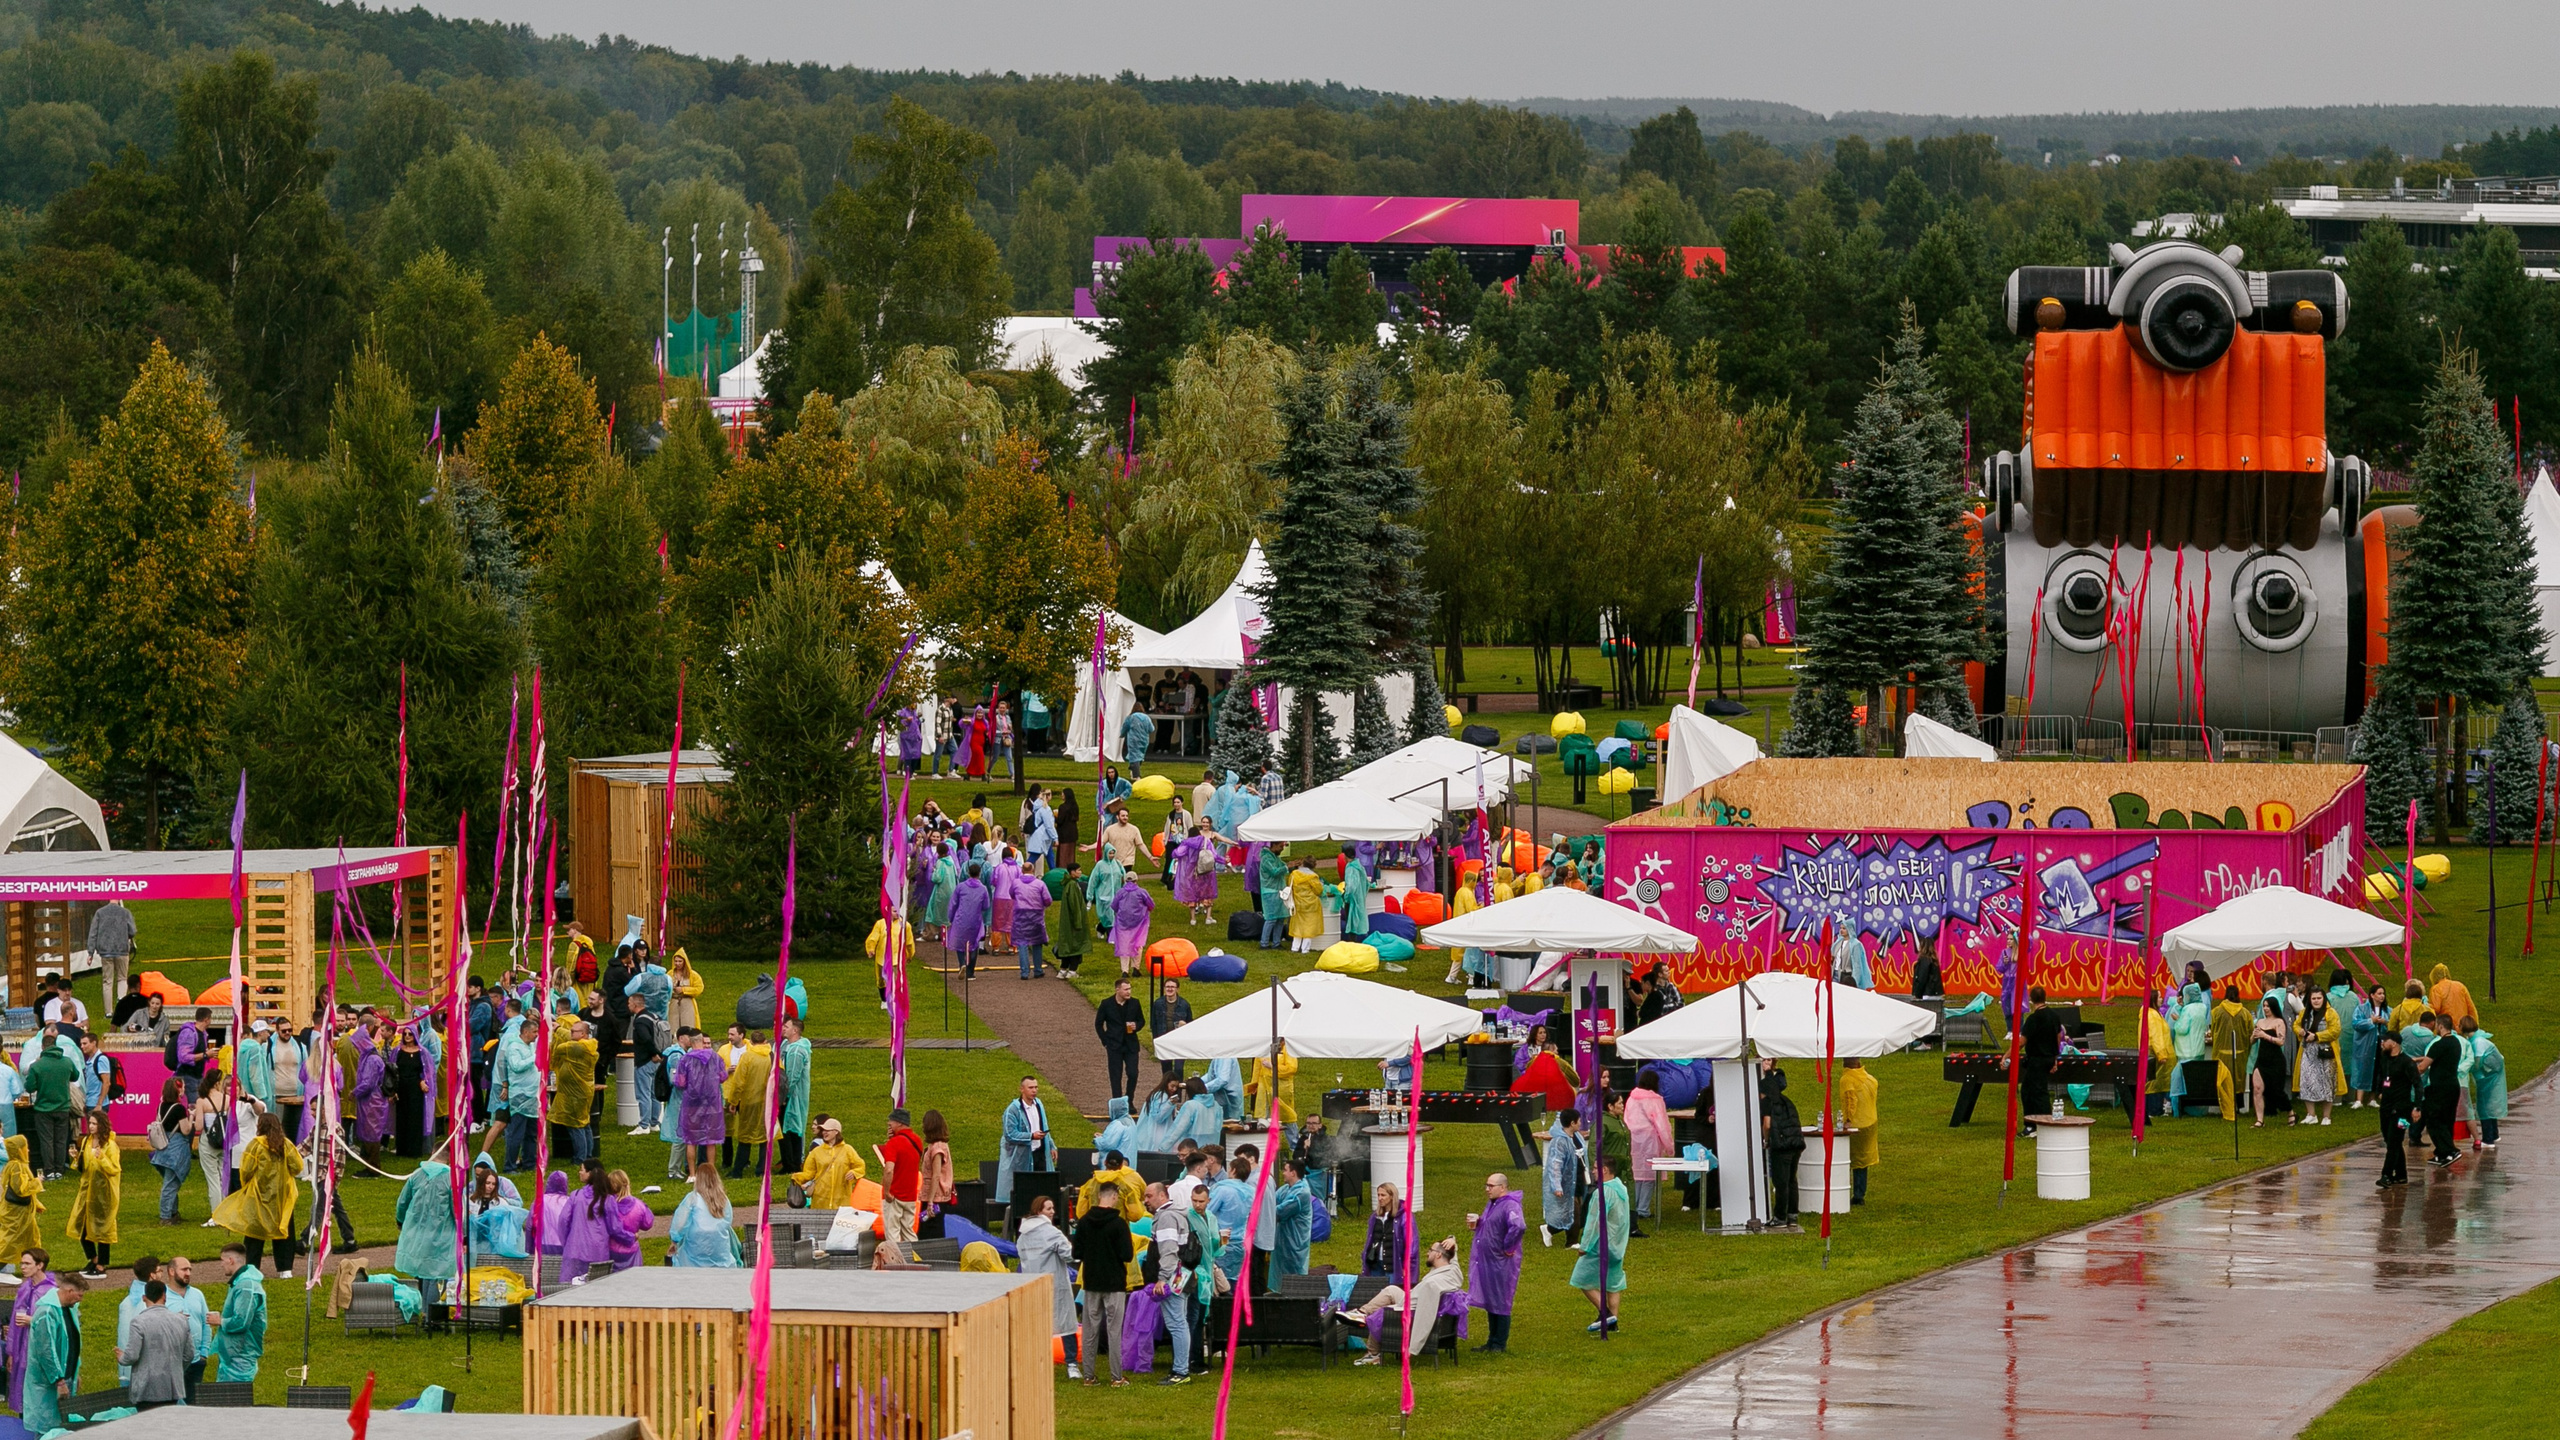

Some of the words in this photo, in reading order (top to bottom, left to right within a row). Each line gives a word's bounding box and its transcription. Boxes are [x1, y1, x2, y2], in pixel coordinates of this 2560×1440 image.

[1790, 859, 1861, 899] КРУШИ
[1897, 857, 1933, 877] БЕЙ
[117, 881, 148, 892] БАР
[1863, 873, 1947, 906] ЛОМАЙ!
